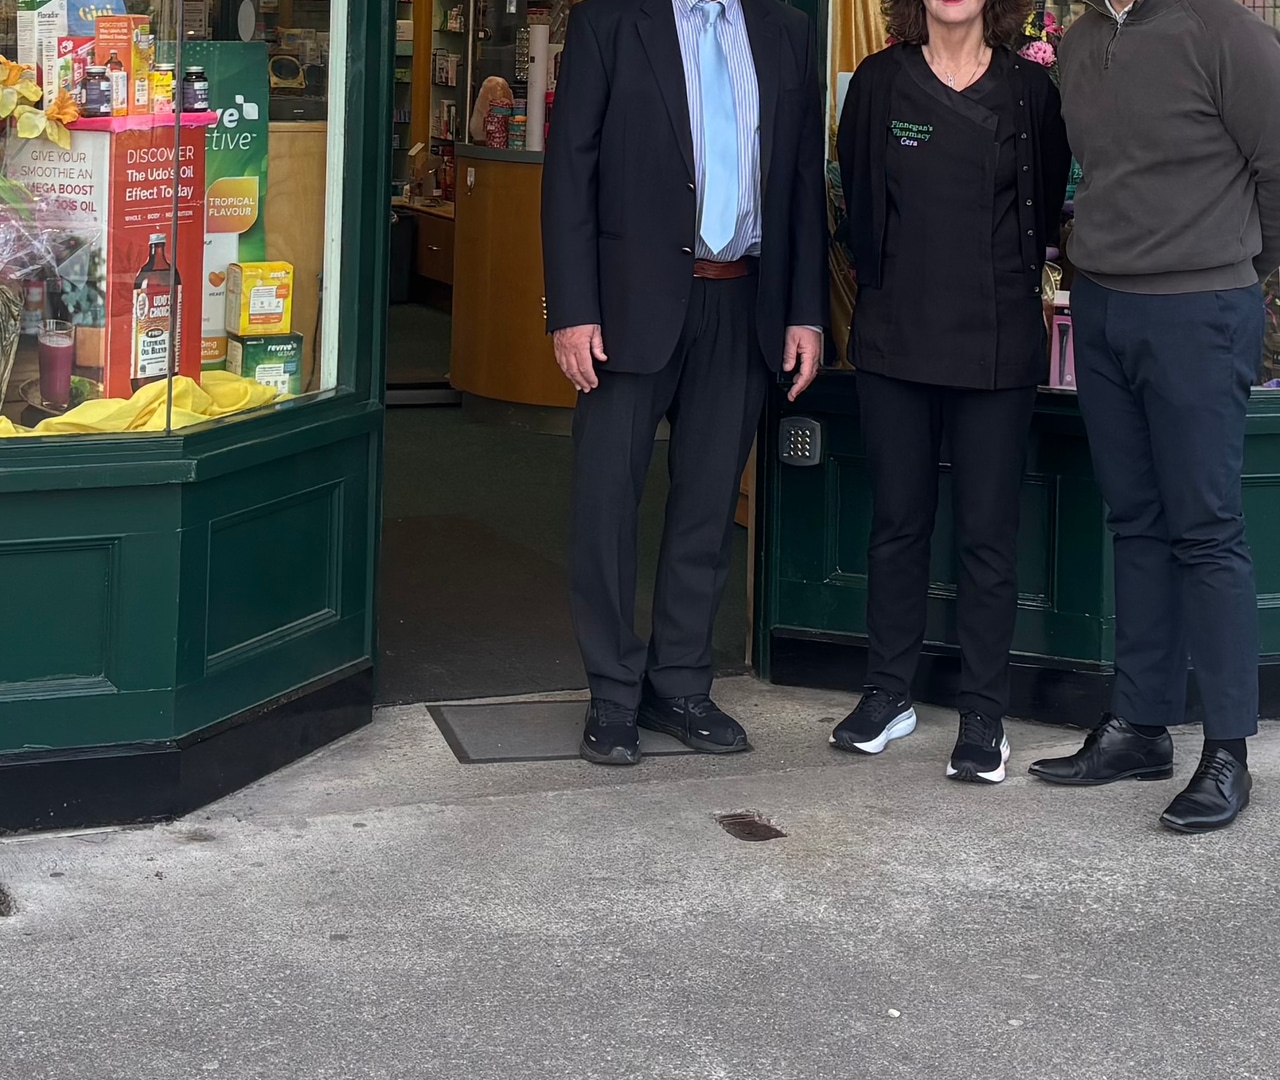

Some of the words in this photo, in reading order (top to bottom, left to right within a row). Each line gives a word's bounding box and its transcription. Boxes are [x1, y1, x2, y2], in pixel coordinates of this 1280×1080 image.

[30, 150, 55, 162] GIVE
[56, 151, 87, 164] YOUR
[127, 145, 195, 164] DISCOVER
[20, 165, 76, 180] SMOOTHIE
[76, 168, 93, 180] AN
[126, 169, 146, 183] The
[147, 167, 175, 181] Udo's
[179, 165, 194, 179] Oil
[58, 183, 95, 196] BOOST
[125, 186, 158, 201] Effect
[80, 200, 97, 212] OIL
[208, 196, 256, 207] TROPICAL
[208, 207, 253, 217] FLAVOUR
